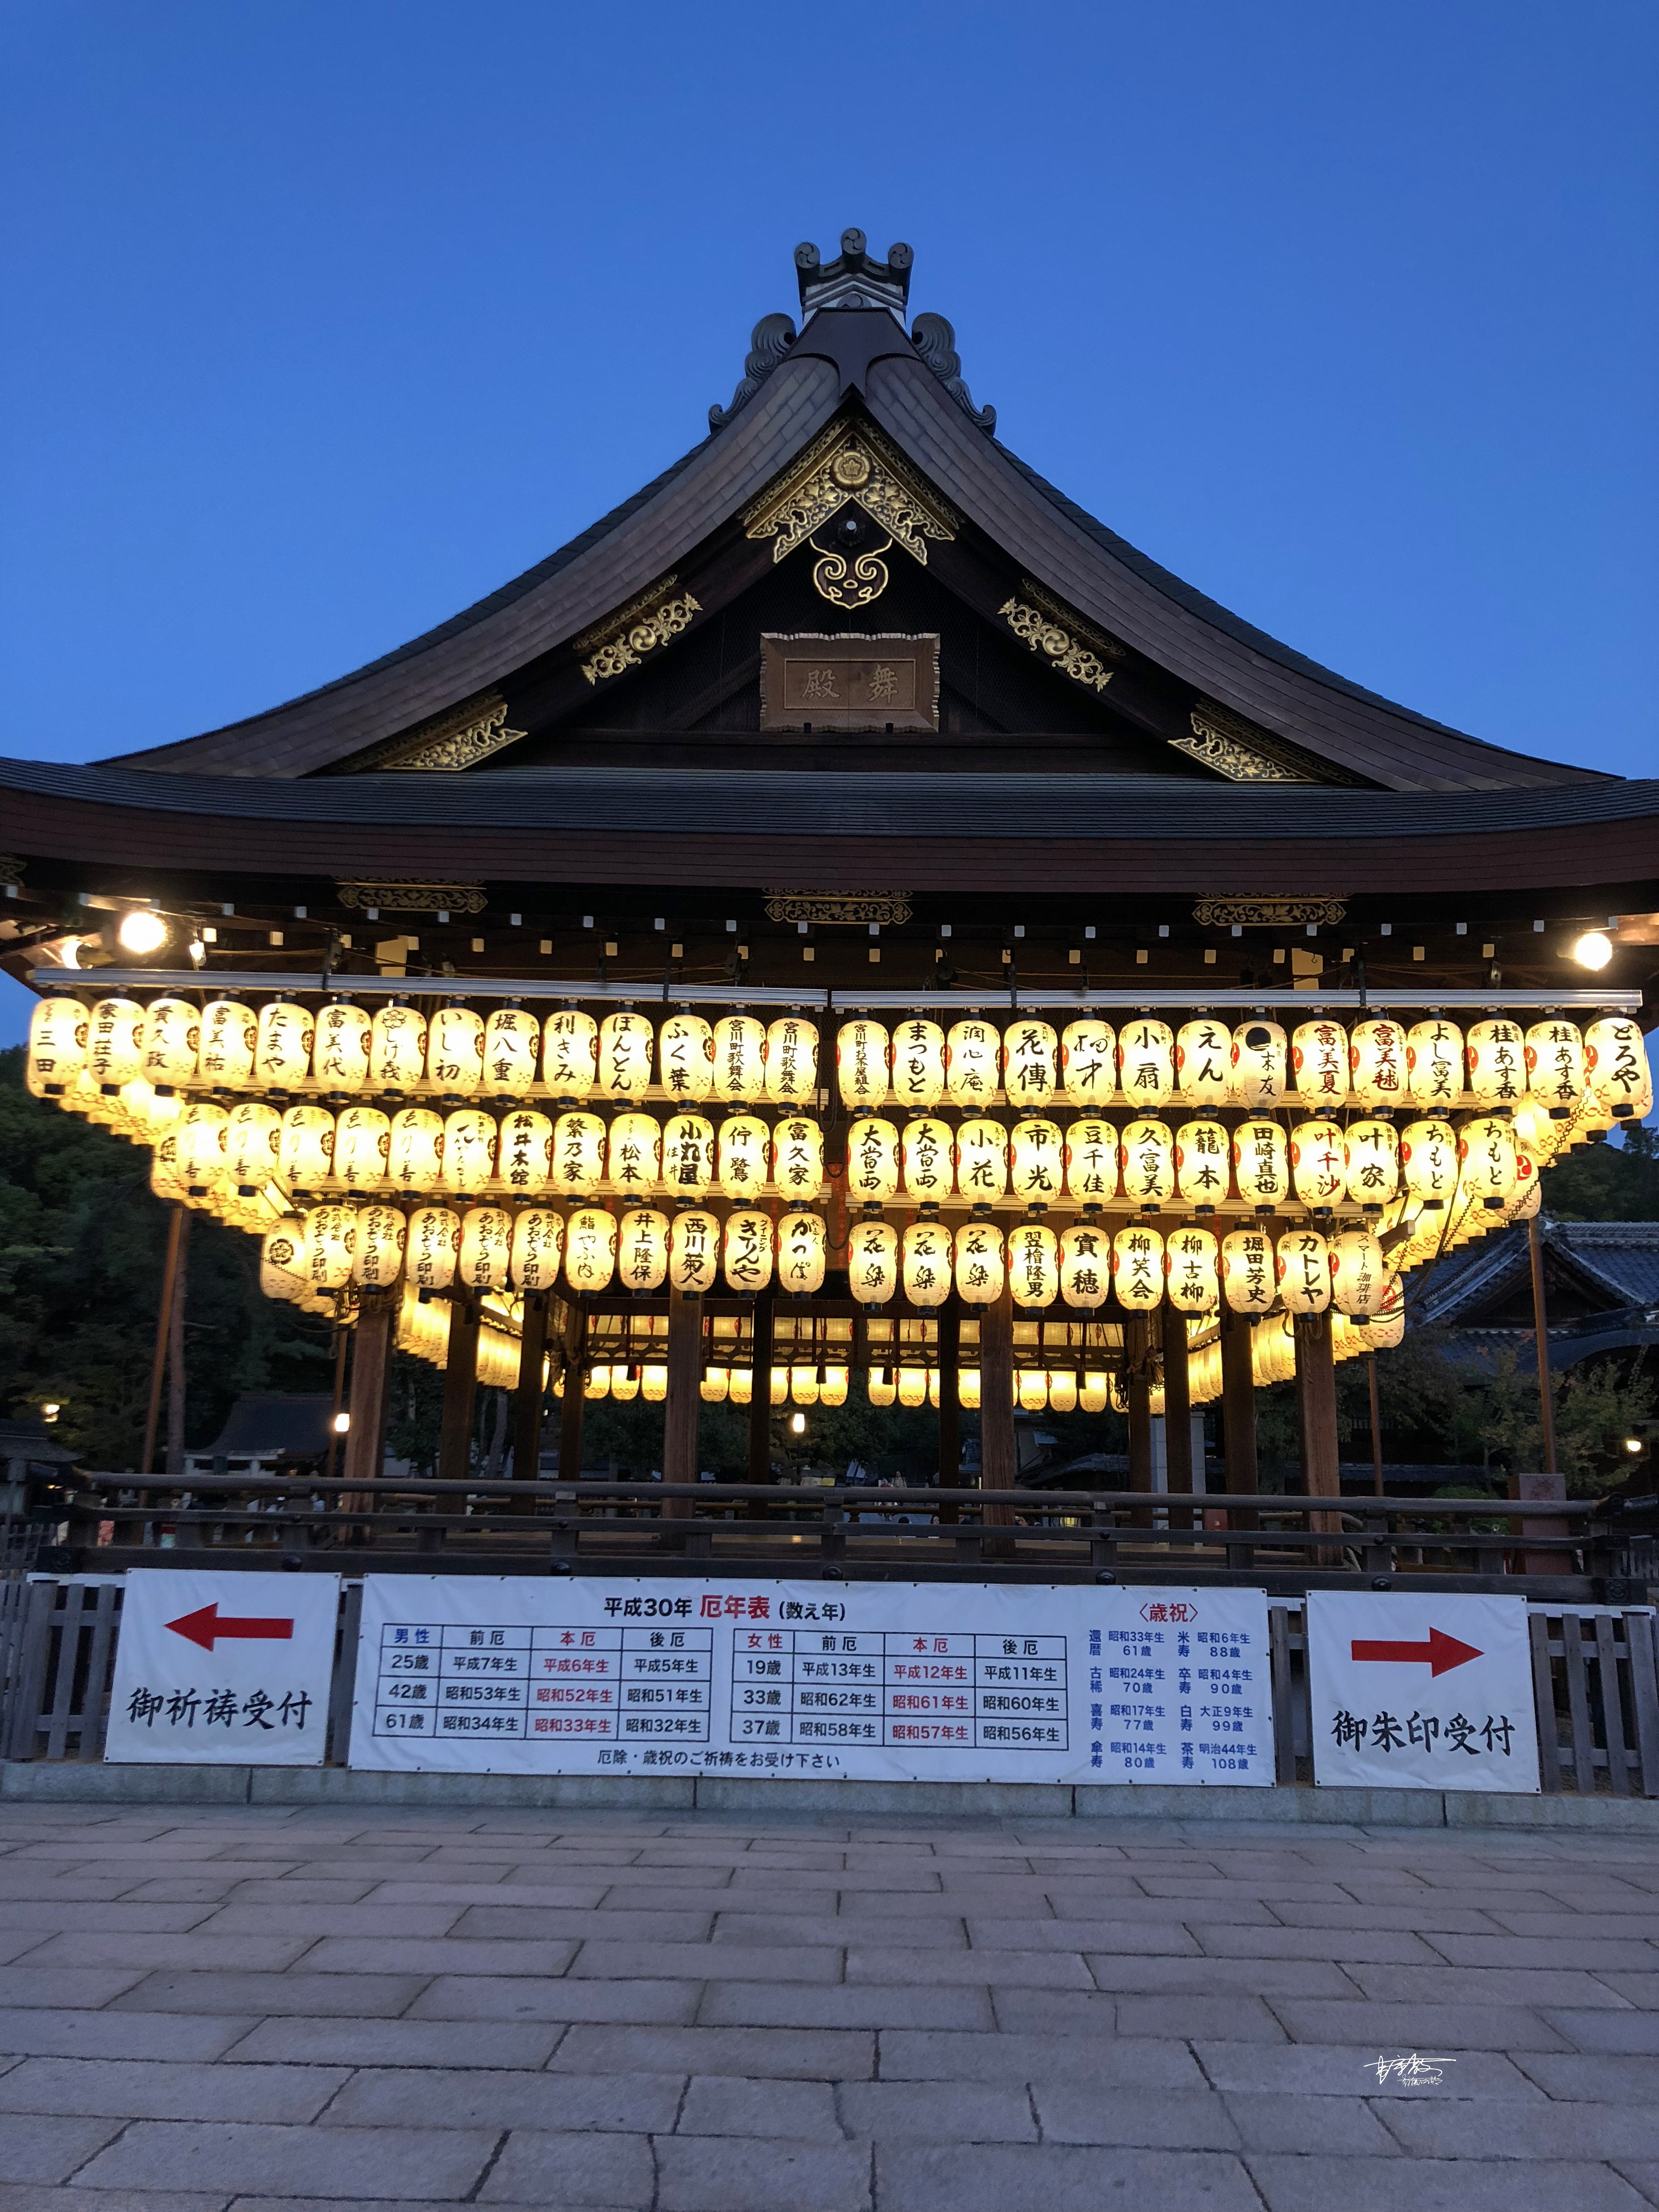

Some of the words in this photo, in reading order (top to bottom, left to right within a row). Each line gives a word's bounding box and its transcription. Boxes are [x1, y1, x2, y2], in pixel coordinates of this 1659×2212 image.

[36, 1030, 57, 1073] 三田
[92, 1002, 119, 1075] 家田荘子
[204, 1005, 232, 1072] 富美祐
[261, 1007, 287, 1074] たまや
[323, 1008, 347, 1077] 富美代
[434, 1012, 462, 1082] いし初
[492, 1013, 518, 1082] 堀八重
[553, 1014, 577, 1083] 利きみ
[668, 1022, 691, 1092] ふく葉
[726, 1019, 747, 1092] 宮川町歌舞会
[777, 1021, 800, 1095] 宮川町歌舞会
[854, 1023, 871, 1095] 宮川町お茶屋組合
[907, 1022, 928, 1093] まつもと
[1015, 1028, 1048, 1093] 花傳
[1133, 1025, 1161, 1090] 小扇
[1198, 1025, 1223, 1083] えん
[1313, 1024, 1342, 1096] 富美夏
[1371, 1023, 1400, 1092] 富美毬
[1430, 1023, 1453, 1099] よし富美
[1488, 1024, 1519, 1099] 桂あす香
[1548, 1025, 1579, 1101] 桂あす香
[1611, 1024, 1640, 1093] どろや
[1259, 1051, 1277, 1096] 末友
[510, 1114, 534, 1186] 松井本館
[562, 1118, 589, 1183] 繁乃家
[618, 1143, 644, 1183] 松本
[678, 1120, 702, 1185] 小丸屋
[787, 1121, 811, 1186] 富久家
[969, 1128, 996, 1188] 小花
[1024, 1124, 1054, 1192] 市光
[1082, 1125, 1105, 1193] 豆千佳
[1137, 1126, 1164, 1197] 久富美
[1193, 1127, 1221, 1190] 籠本
[1252, 1127, 1279, 1194] 田崎真也
[1313, 1127, 1341, 1197] 叶千沙
[1358, 1127, 1386, 1188] 叶家
[1426, 1124, 1444, 1190] ちもと
[1483, 1120, 1503, 1186] ちもと
[470, 1211, 494, 1286] あおぞら印刷
[521, 1213, 543, 1287] あおぞら印刷
[630, 1212, 656, 1282] 井上隆保
[680, 1217, 708, 1285] 西川菊人
[1023, 1231, 1047, 1298] 翌檜隆男
[1070, 1232, 1100, 1295] 實穂
[1127, 1233, 1155, 1300] 柳笑会
[1180, 1234, 1205, 1304] 柳古柳
[1243, 1237, 1268, 1304] 堀田芳史
[1298, 1234, 1324, 1305] カトレヤ
[1356, 1234, 1372, 1305] スマート珈琲店
[604, 1597, 692, 1617] 平成30年
[700, 1595, 770, 1619] 厄年表
[779, 1601, 846, 1622] (数え年)
[394, 1628, 430, 1644] 男性
[470, 1629, 505, 1646] 前厄
[560, 1630, 596, 1646] 本厄
[650, 1632, 685, 1647] 後厄
[748, 1633, 783, 1649] 女性
[822, 1635, 857, 1651] 前厄
[913, 1637, 949, 1653] 本厄
[1003, 1639, 1039, 1655] 後厄
[1089, 1629, 1102, 1656] 還暦
[1108, 1631, 1165, 1643] 昭和33年生
[1177, 1631, 1190, 1657] 米寿
[1198, 1632, 1251, 1644] 昭和6年生
[391, 1654, 429, 1670] 25歳
[454, 1656, 518, 1671] 平成7年生
[1123, 1645, 1152, 1657] 61歳
[1210, 1646, 1241, 1658] 88歳
[544, 1658, 609, 1673] 平成6年生
[634, 1658, 698, 1673] 平成5年生
[747, 1660, 781, 1676] 19歳
[802, 1662, 876, 1677] 平成13年生
[894, 1664, 968, 1680] 平成12年生
[984, 1666, 1058, 1681] 平成11年生
[1109, 1668, 1165, 1680] 昭和24年生
[1198, 1669, 1253, 1681] 昭和4年生
[388, 1684, 427, 1700] 42歳
[446, 1685, 521, 1702] 昭和53年生
[1090, 1667, 1102, 1694] 古稀
[1124, 1682, 1153, 1694] 70歳
[1179, 1667, 1192, 1694] 卒寿
[1210, 1683, 1243, 1695] 90歳
[126, 1686, 313, 1730] 御祈祷受付
[537, 1688, 613, 1703] 昭和52年生
[627, 1689, 703, 1703] 昭和51年生
[743, 1689, 781, 1706] 33歳
[800, 1692, 877, 1708] 昭和62年生
[893, 1695, 969, 1710] 昭和61年生
[983, 1696, 1059, 1712] 昭和60年生
[386, 1713, 424, 1730] 61歳
[443, 1716, 518, 1731] 昭和34年生
[1090, 1703, 1103, 1731] 喜寿
[1110, 1705, 1166, 1717] 昭和17年生
[1180, 1705, 1193, 1732] 白寿
[1200, 1705, 1254, 1718] 大正9年生
[535, 1718, 611, 1734] 昭和33年生
[625, 1718, 702, 1734] 昭和32年生
[742, 1719, 781, 1736] 37歳
[800, 1722, 877, 1739] 昭和58年生
[892, 1725, 969, 1740] 昭和57年生
[983, 1726, 1060, 1742] 昭和56年生
[1124, 1719, 1154, 1731] 77歳
[1212, 1720, 1243, 1733] 99歳
[1331, 1710, 1516, 1757] 御朱印受付
[1091, 1741, 1103, 1769] 傘寿
[1110, 1742, 1167, 1755] 昭和14年生
[1181, 1742, 1194, 1769] 茶寿
[1199, 1743, 1257, 1756] 明治44年生
[1125, 1757, 1155, 1769] 80歳
[1212, 1758, 1249, 1770] 108歳
